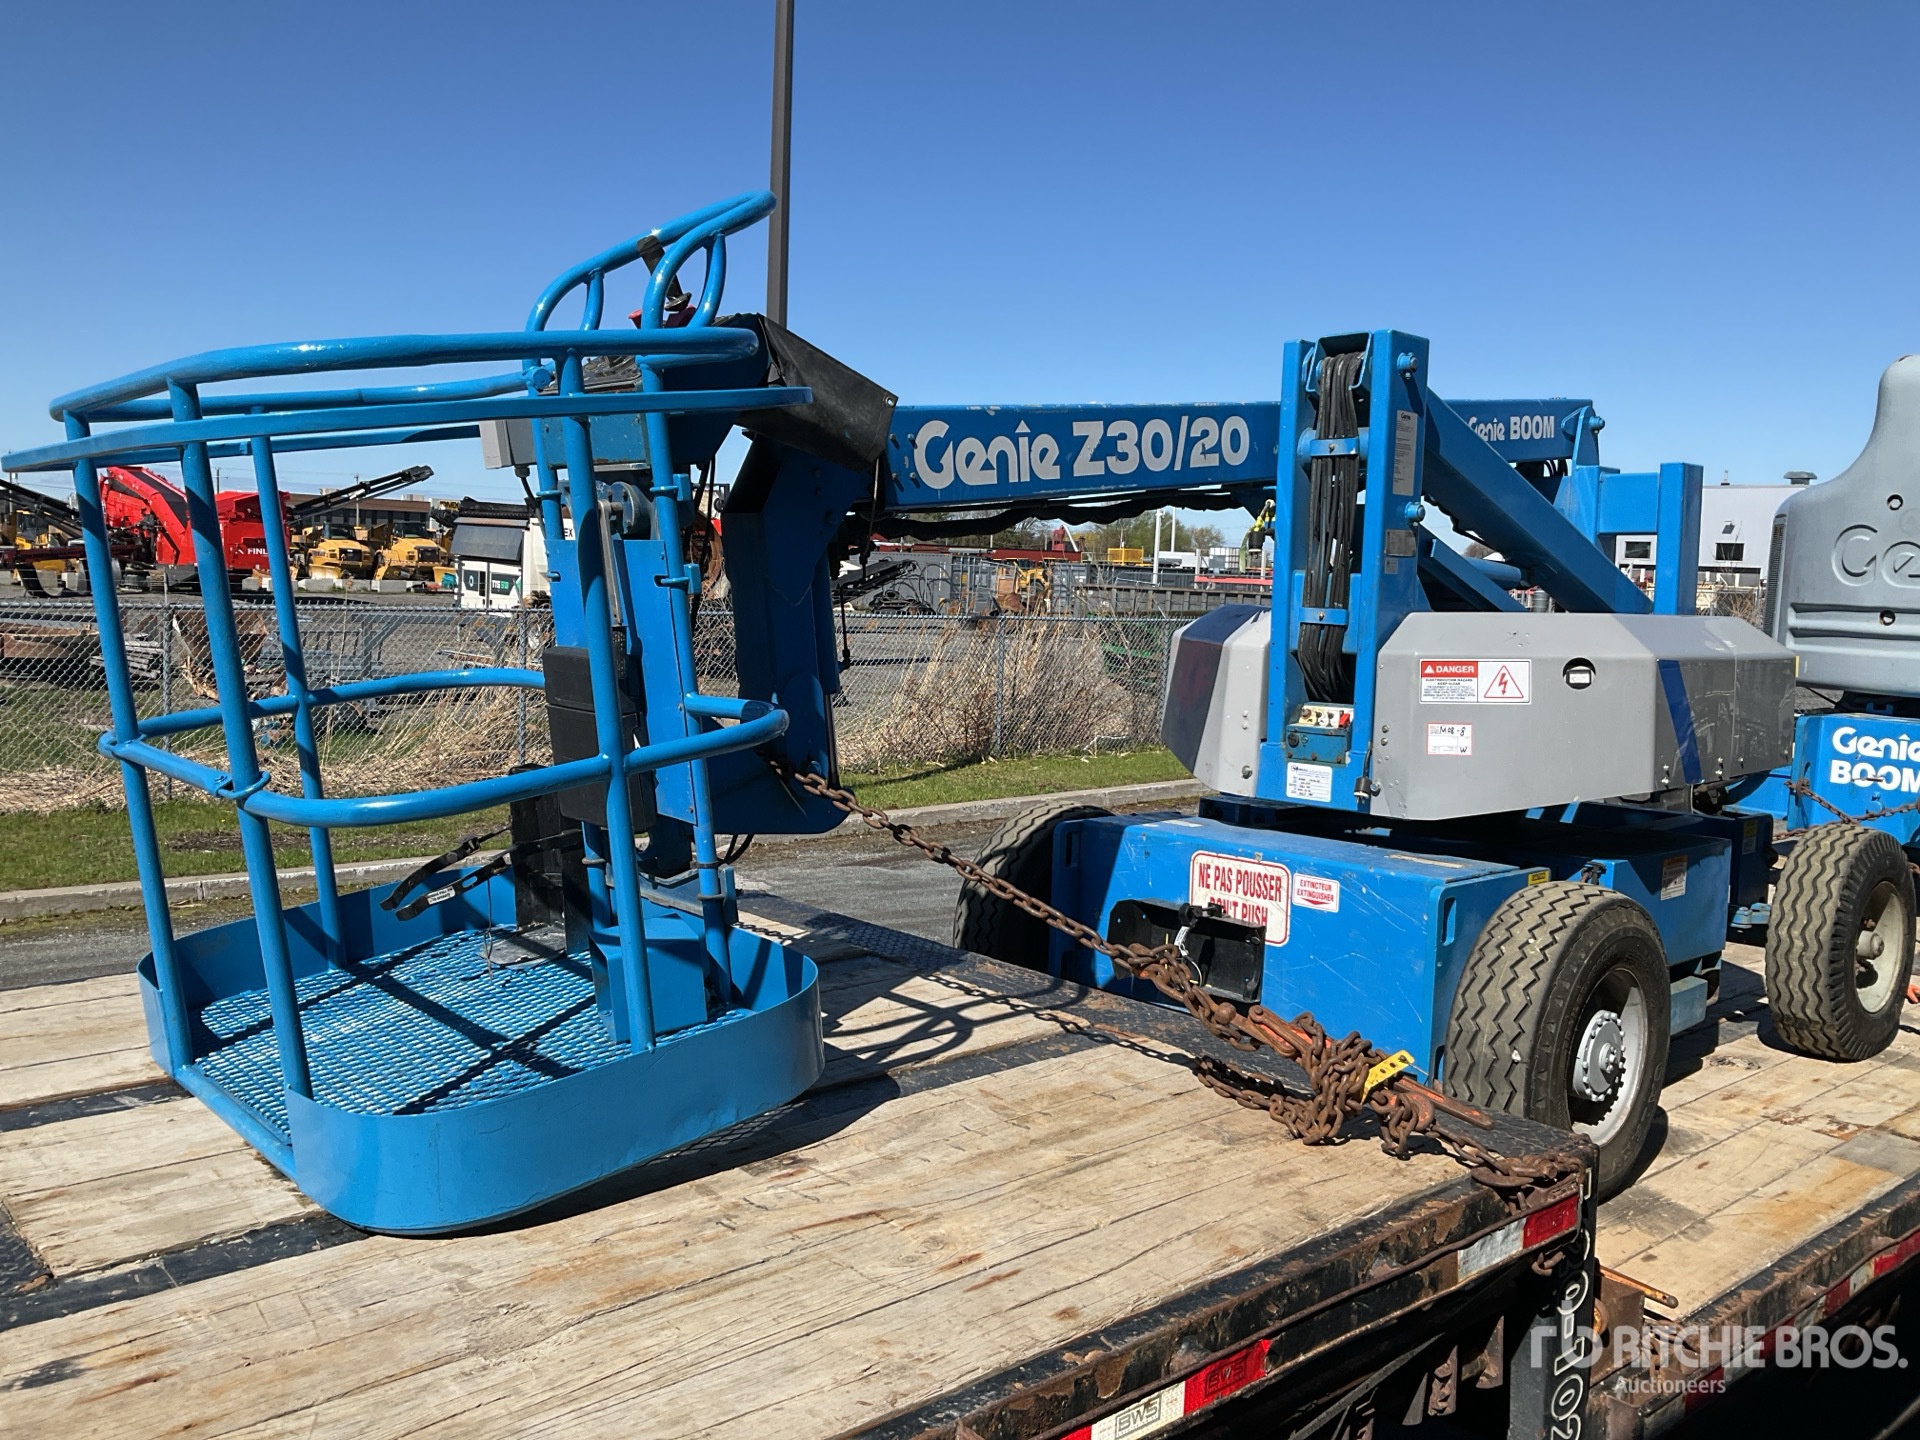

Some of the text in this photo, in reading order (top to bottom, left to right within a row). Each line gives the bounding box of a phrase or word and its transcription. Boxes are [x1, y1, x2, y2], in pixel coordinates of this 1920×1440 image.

[1509, 415, 1555, 440] BOOM
[914, 415, 1250, 490] Genie Z30/20
[1436, 665, 1475, 674] DANGER
[1198, 862, 1282, 903] NE PAS POUSSER
[1296, 888, 1335, 902] EXTINGUISHER
[1299, 879, 1332, 892] EXTINCTEUR
[1118, 1400, 1158, 1433] BWS
